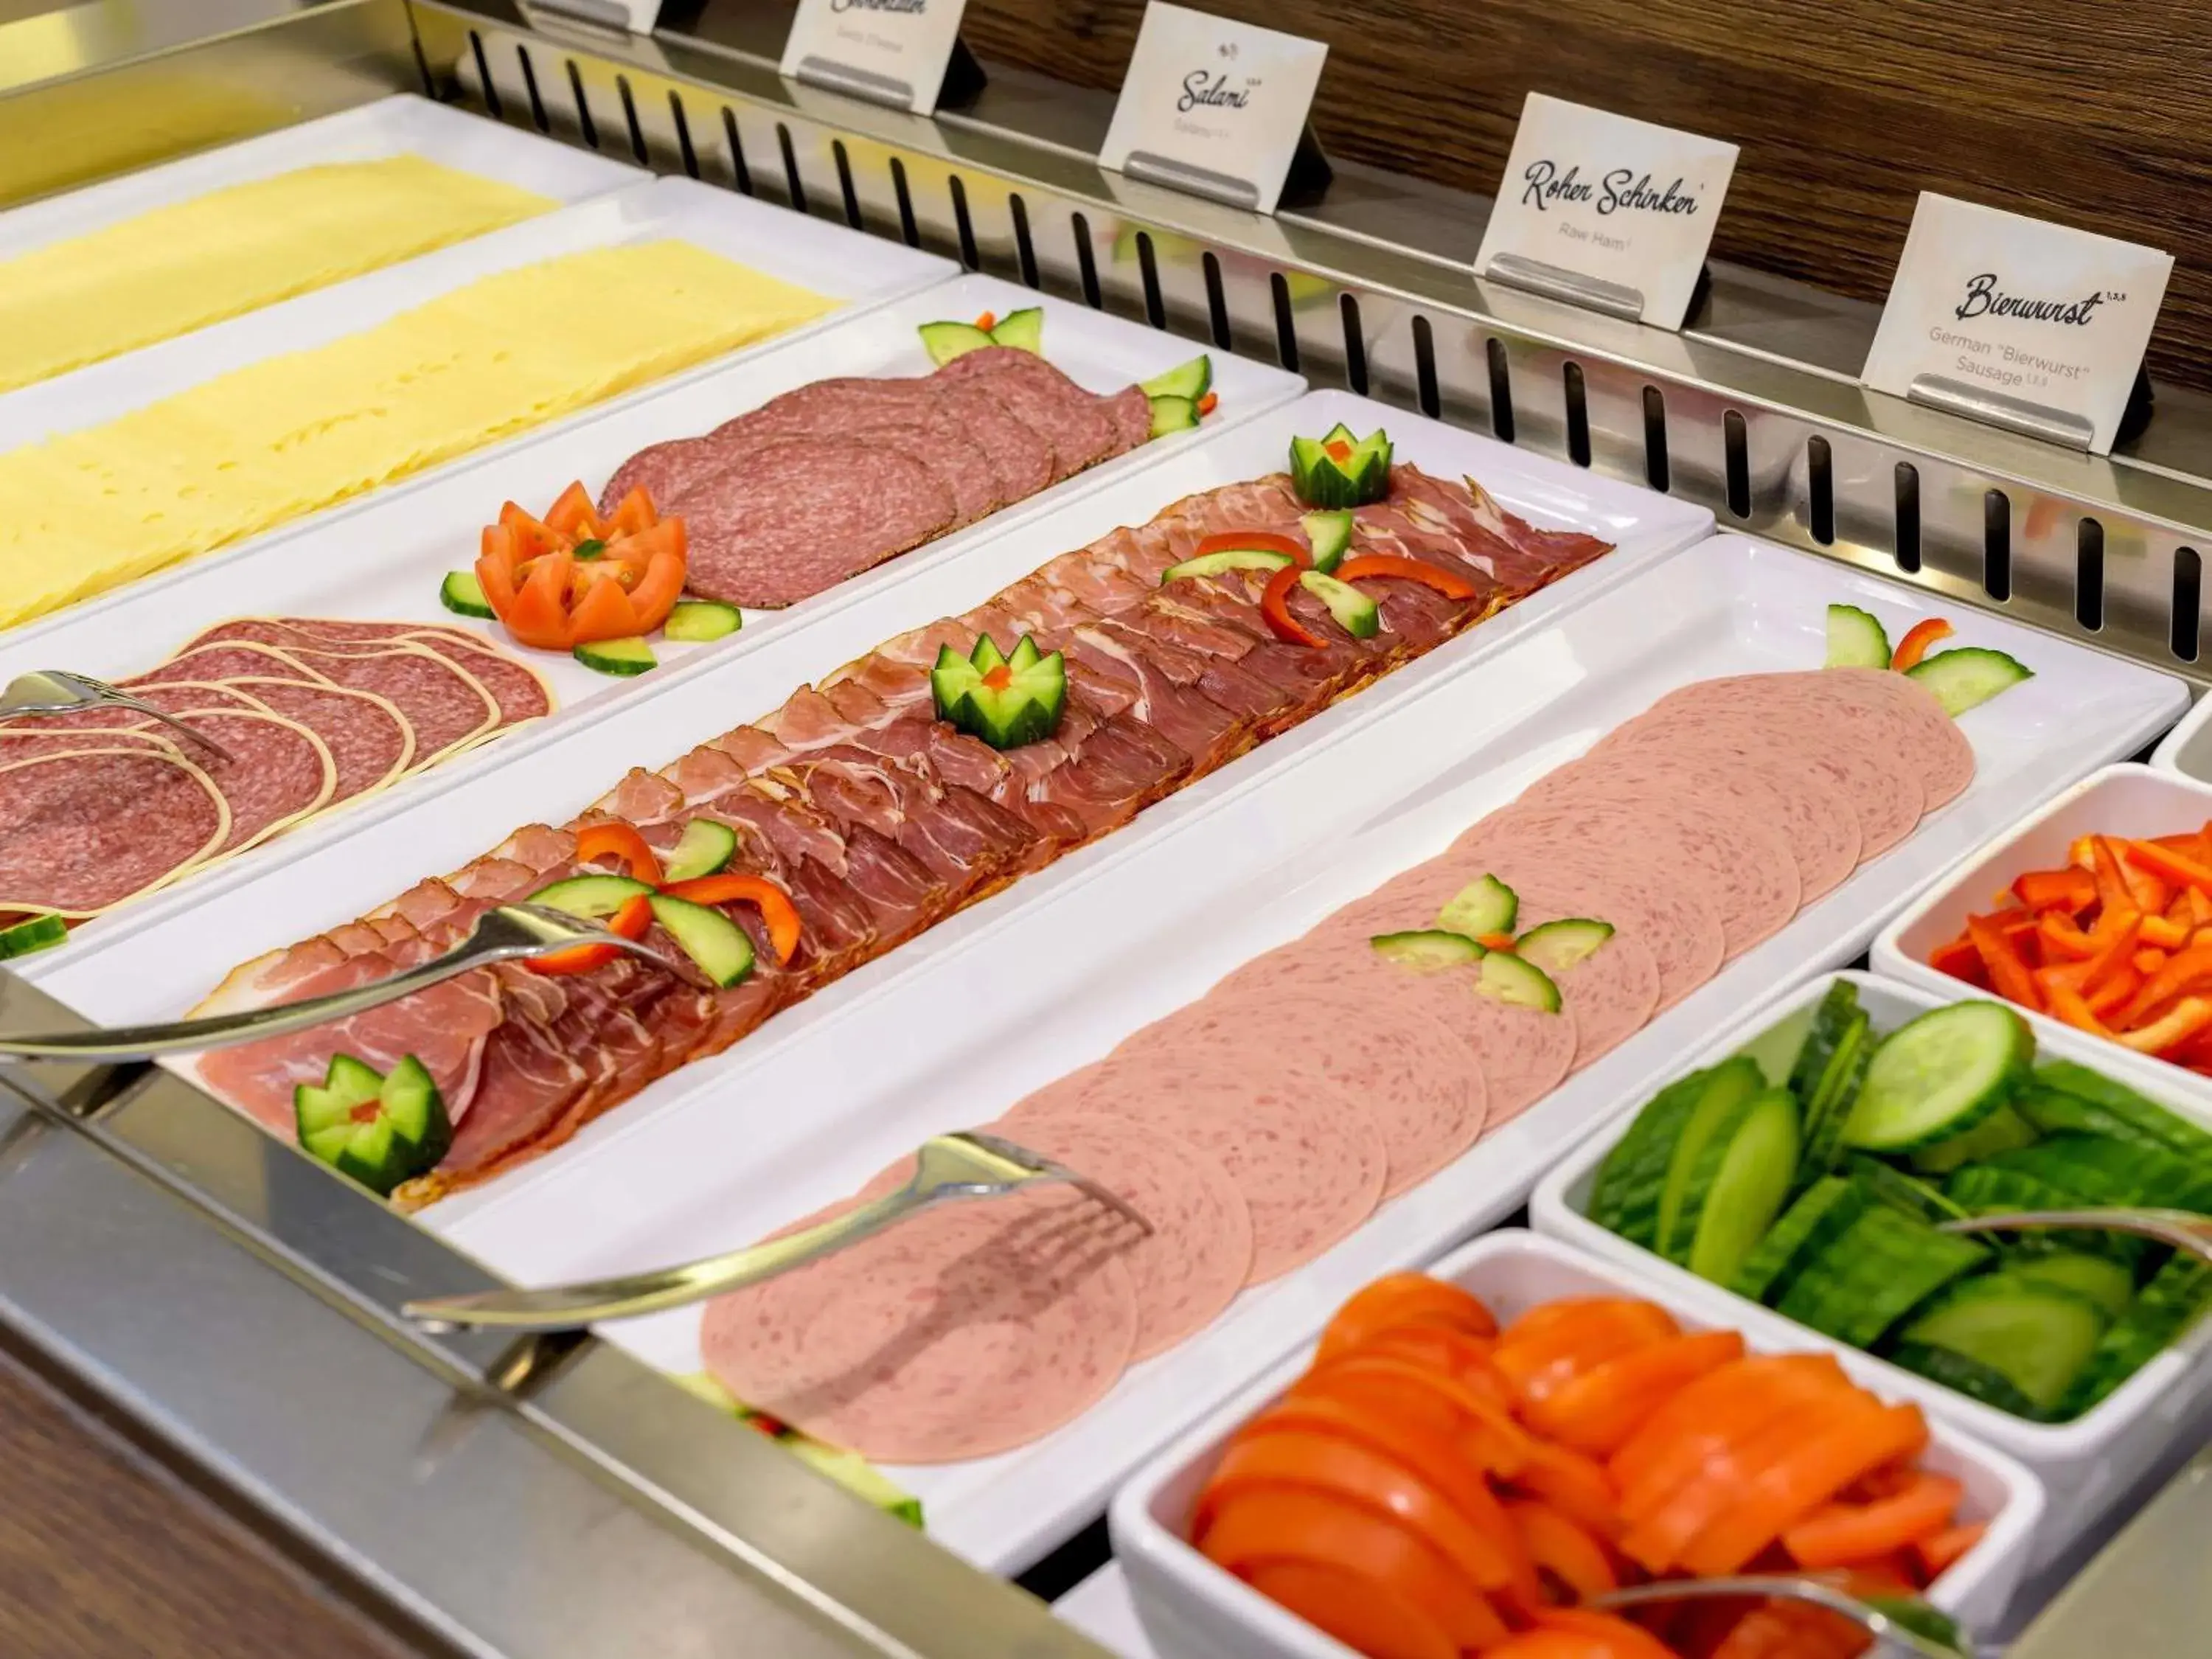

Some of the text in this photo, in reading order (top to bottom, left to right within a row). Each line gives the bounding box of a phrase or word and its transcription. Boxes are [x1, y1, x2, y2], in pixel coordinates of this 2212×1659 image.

[1178, 69, 1250, 112] Salami
[1522, 160, 1593, 211] Roher
[1596, 169, 1698, 215] Schinken
[1558, 222, 1588, 242] Raw
[1590, 231, 1624, 251] Ham
[1955, 273, 2104, 326] Bierwurst
[1929, 326, 2090, 380] German "Bierwurst"
[1955, 355, 2023, 386] Sausage
